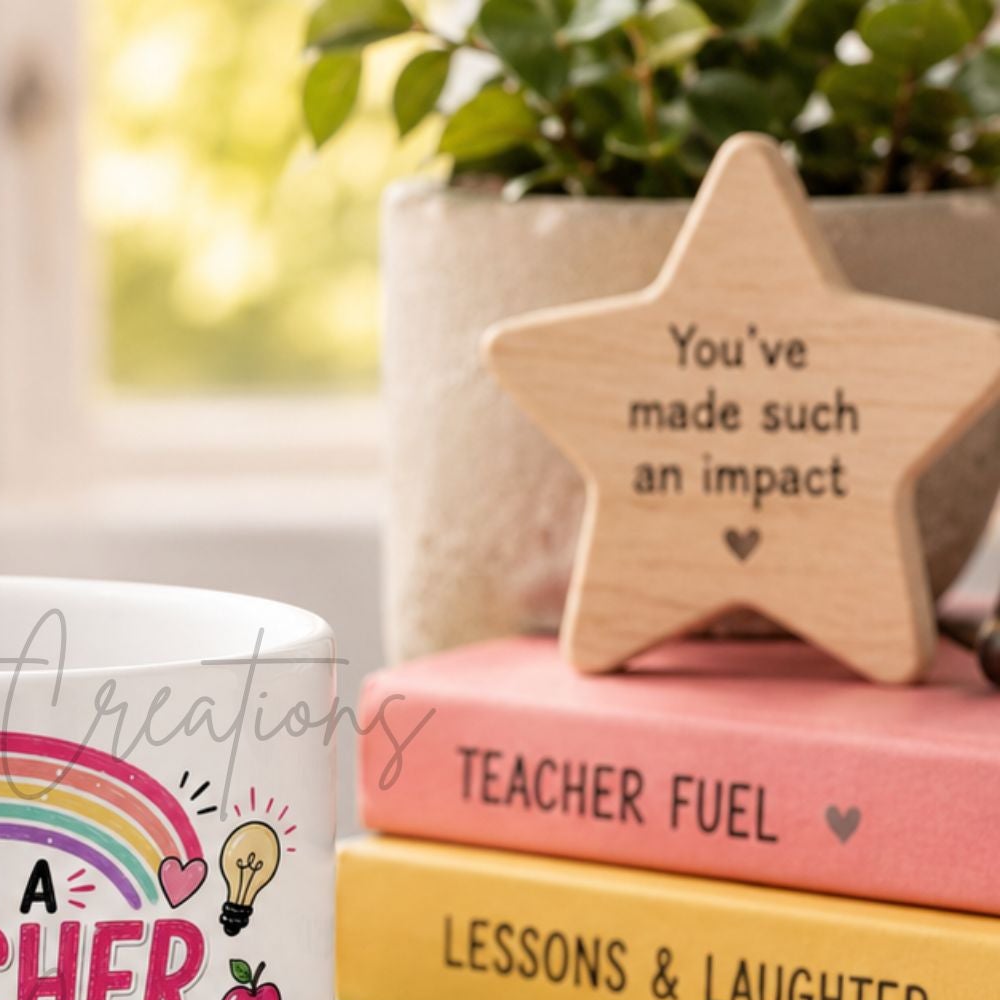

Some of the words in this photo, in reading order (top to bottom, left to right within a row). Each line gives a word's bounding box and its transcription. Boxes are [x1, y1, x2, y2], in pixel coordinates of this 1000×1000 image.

[668, 322, 809, 369] You've
[628, 386, 742, 432] made
[761, 387, 860, 432] such
[633, 462, 684, 495] an
[702, 452, 848, 512] impact
[457, 746, 646, 826] TEACHER
[670, 775, 780, 844] FUEL
[19, 858, 58, 915] A
[444, 915, 628, 995] LESSONS
